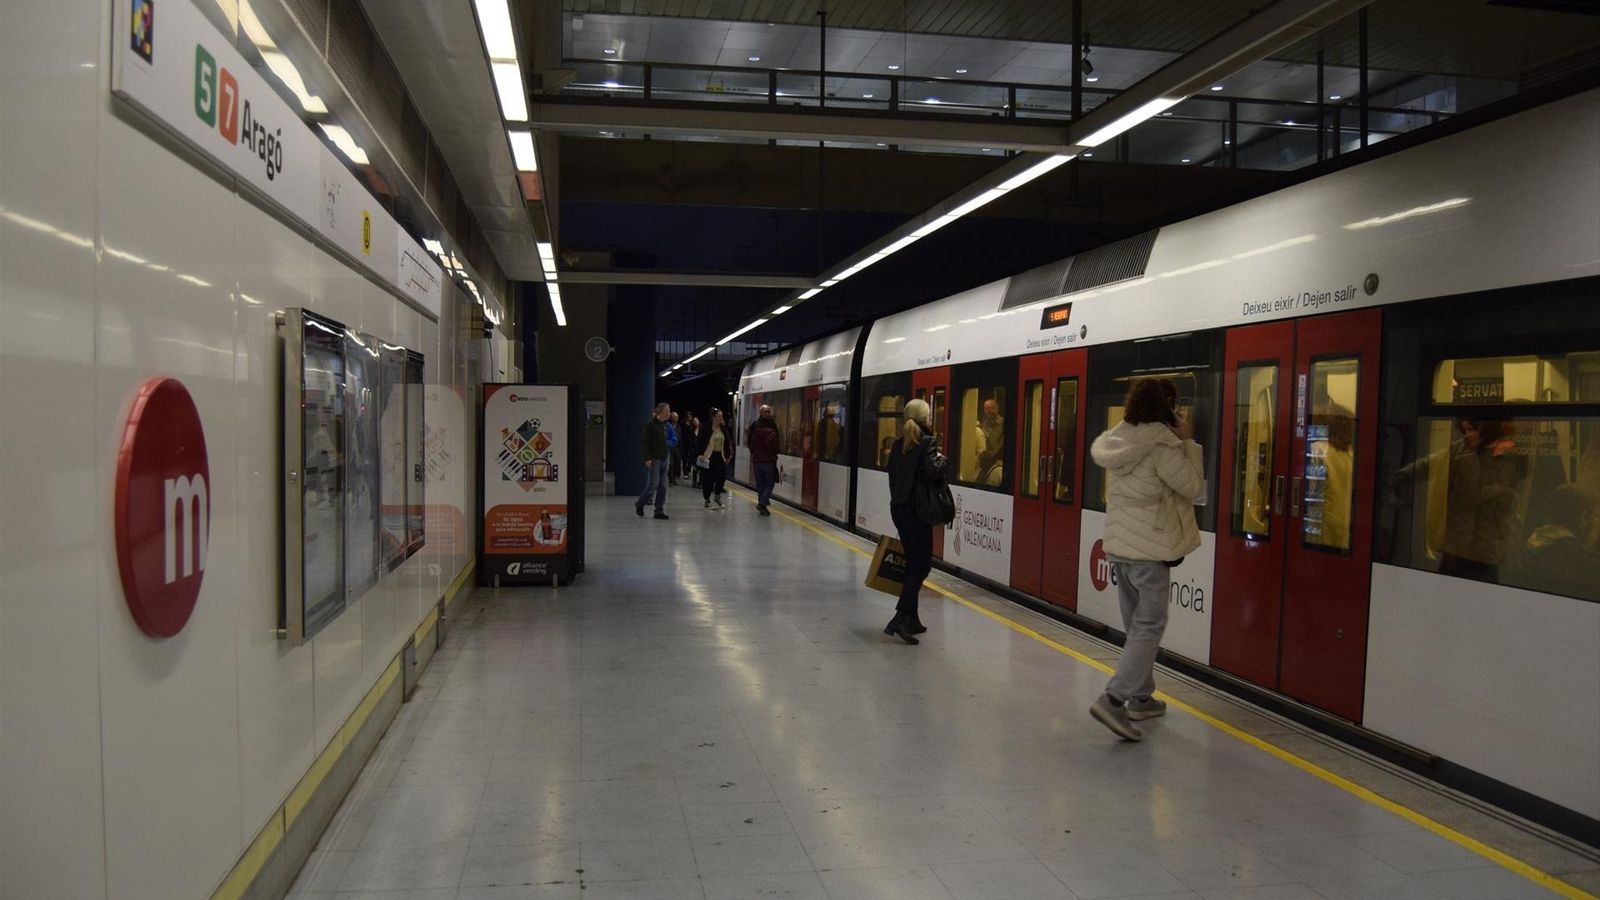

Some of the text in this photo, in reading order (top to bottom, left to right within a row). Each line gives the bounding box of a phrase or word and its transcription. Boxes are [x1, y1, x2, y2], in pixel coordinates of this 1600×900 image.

[200, 68, 283, 181] 5 7 Aragó
[1243, 302, 1272, 315] Deixeu
[1275, 296, 1294, 311] eixir
[1303, 291, 1331, 308] Dejen
[1334, 285, 1357, 302] salir
[594, 346, 602, 358] 2
[165, 473, 208, 585] m
[964, 511, 1004, 533] GENERALITAT
[964, 530, 1002, 553] VALENCIANA
